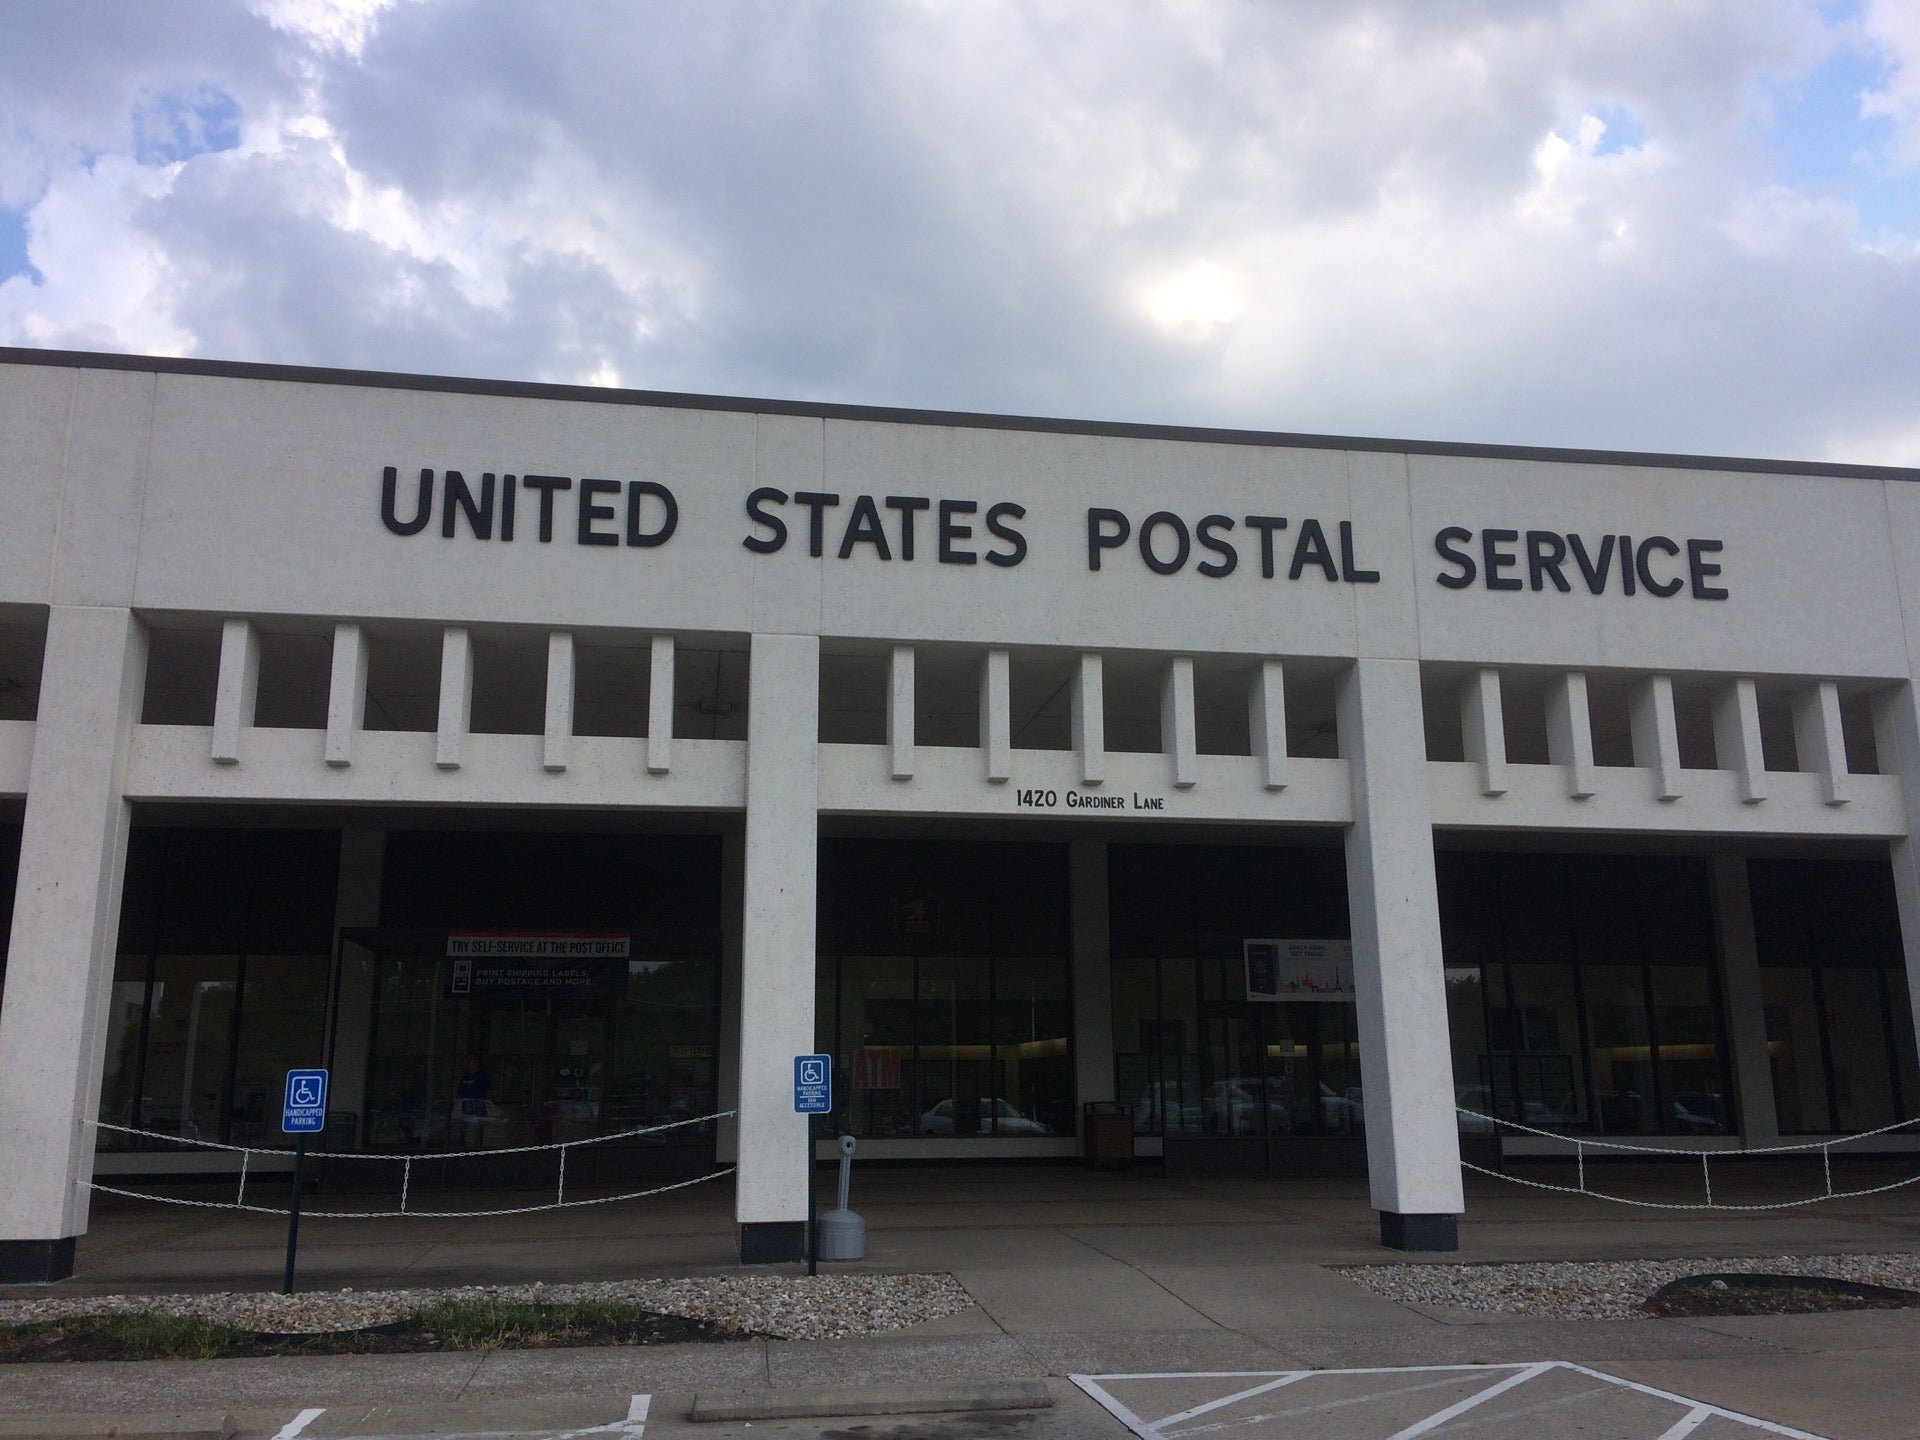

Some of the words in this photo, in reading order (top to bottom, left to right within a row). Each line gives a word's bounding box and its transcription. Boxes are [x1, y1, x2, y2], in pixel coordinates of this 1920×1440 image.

[379, 466, 679, 548] UNITED
[742, 487, 1028, 568] STATES
[1087, 507, 1381, 584] POSTAL
[1434, 526, 1729, 600] SERVICE
[1016, 789, 1057, 808] 1420
[452, 940, 469, 953] TRY
[471, 940, 535, 954] SELF-SERVICE
[536, 941, 548, 954] AT
[550, 941, 568, 954] THE
[569, 941, 594, 954] POST
[595, 941, 627, 954] OFFICE
[476, 969, 503, 977] PRINT
[506, 969, 549, 977] SHIPPING
[855, 1050, 900, 1088] ATM
[285, 1108, 323, 1117] HANDICAPPED
[290, 1117, 316, 1125] PARKING
